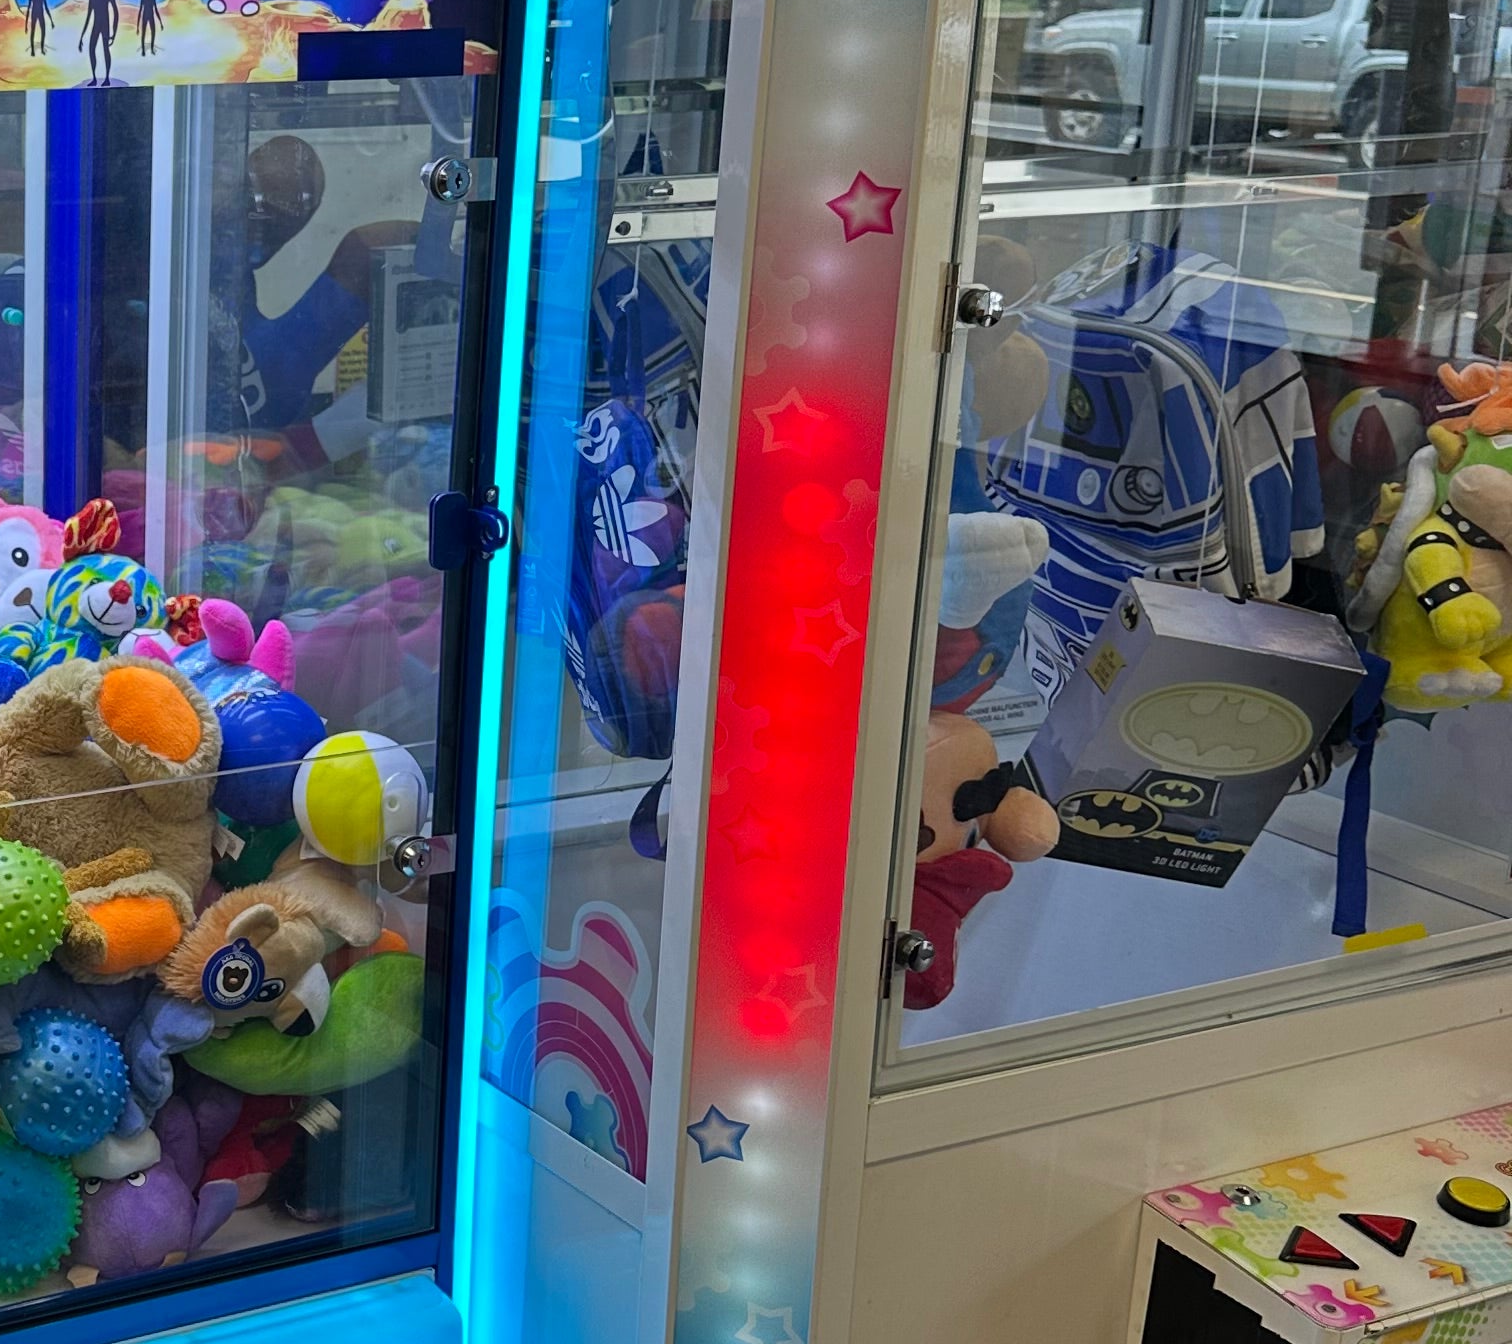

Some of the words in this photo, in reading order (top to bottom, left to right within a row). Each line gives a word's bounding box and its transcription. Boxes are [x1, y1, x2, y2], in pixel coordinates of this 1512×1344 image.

[1173, 847, 1216, 862] BATMAN
[1152, 856, 1169, 866] 3D
[1168, 859, 1189, 870] LED
[1190, 861, 1224, 875] LIGHT
